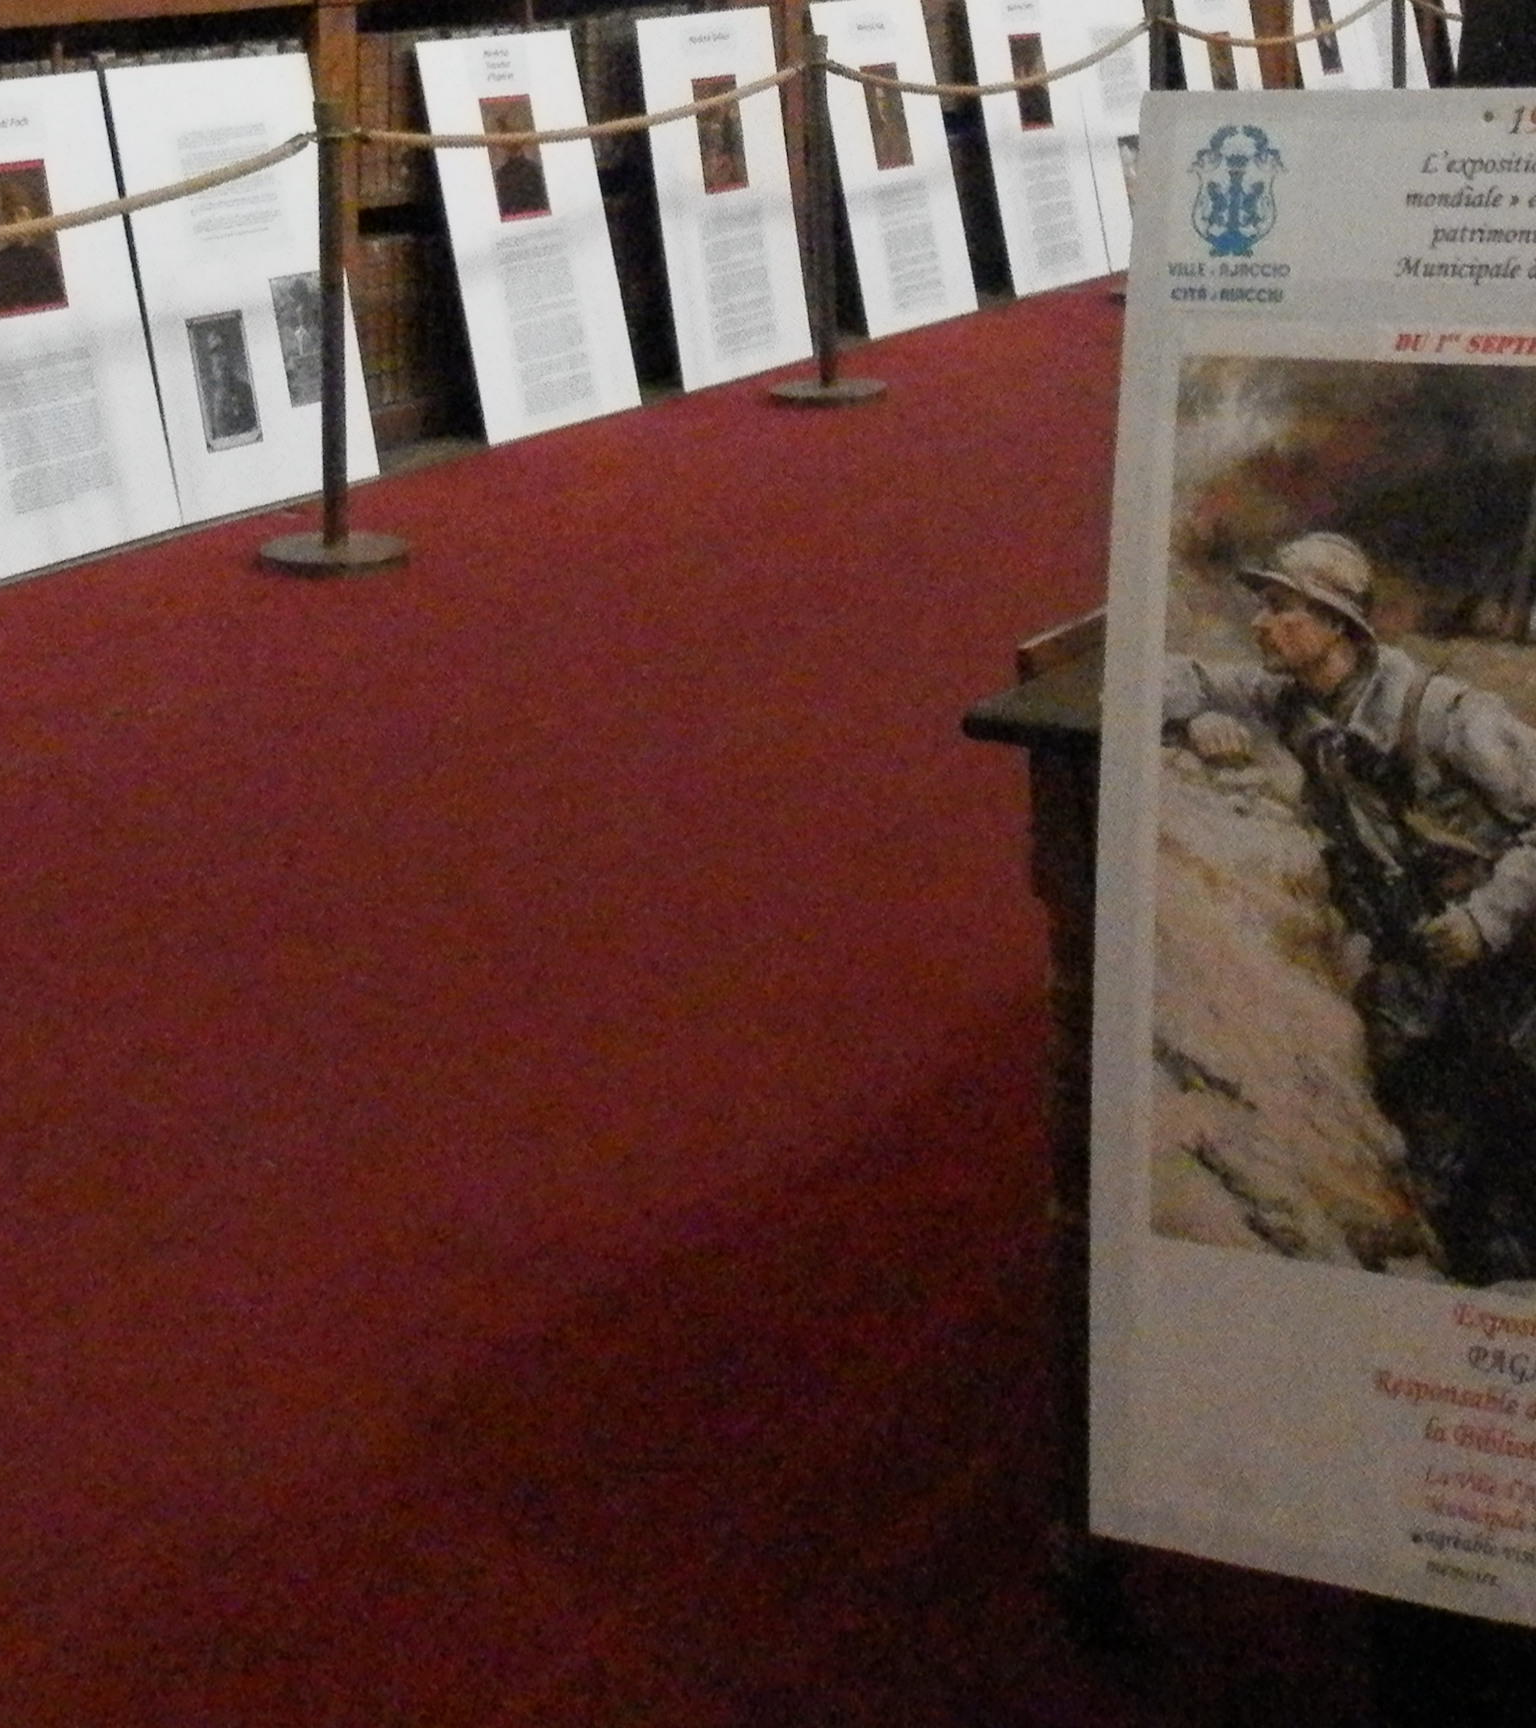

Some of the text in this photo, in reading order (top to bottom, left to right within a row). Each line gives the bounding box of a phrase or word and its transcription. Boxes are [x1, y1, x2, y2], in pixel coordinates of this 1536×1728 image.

[1406, 185, 1503, 209] mondiale
[1395, 256, 1520, 285] Municipale
[1395, 332, 1430, 352] DU
[1375, 1369, 1519, 1416] Responsable
[1425, 1416, 1445, 1443] la
